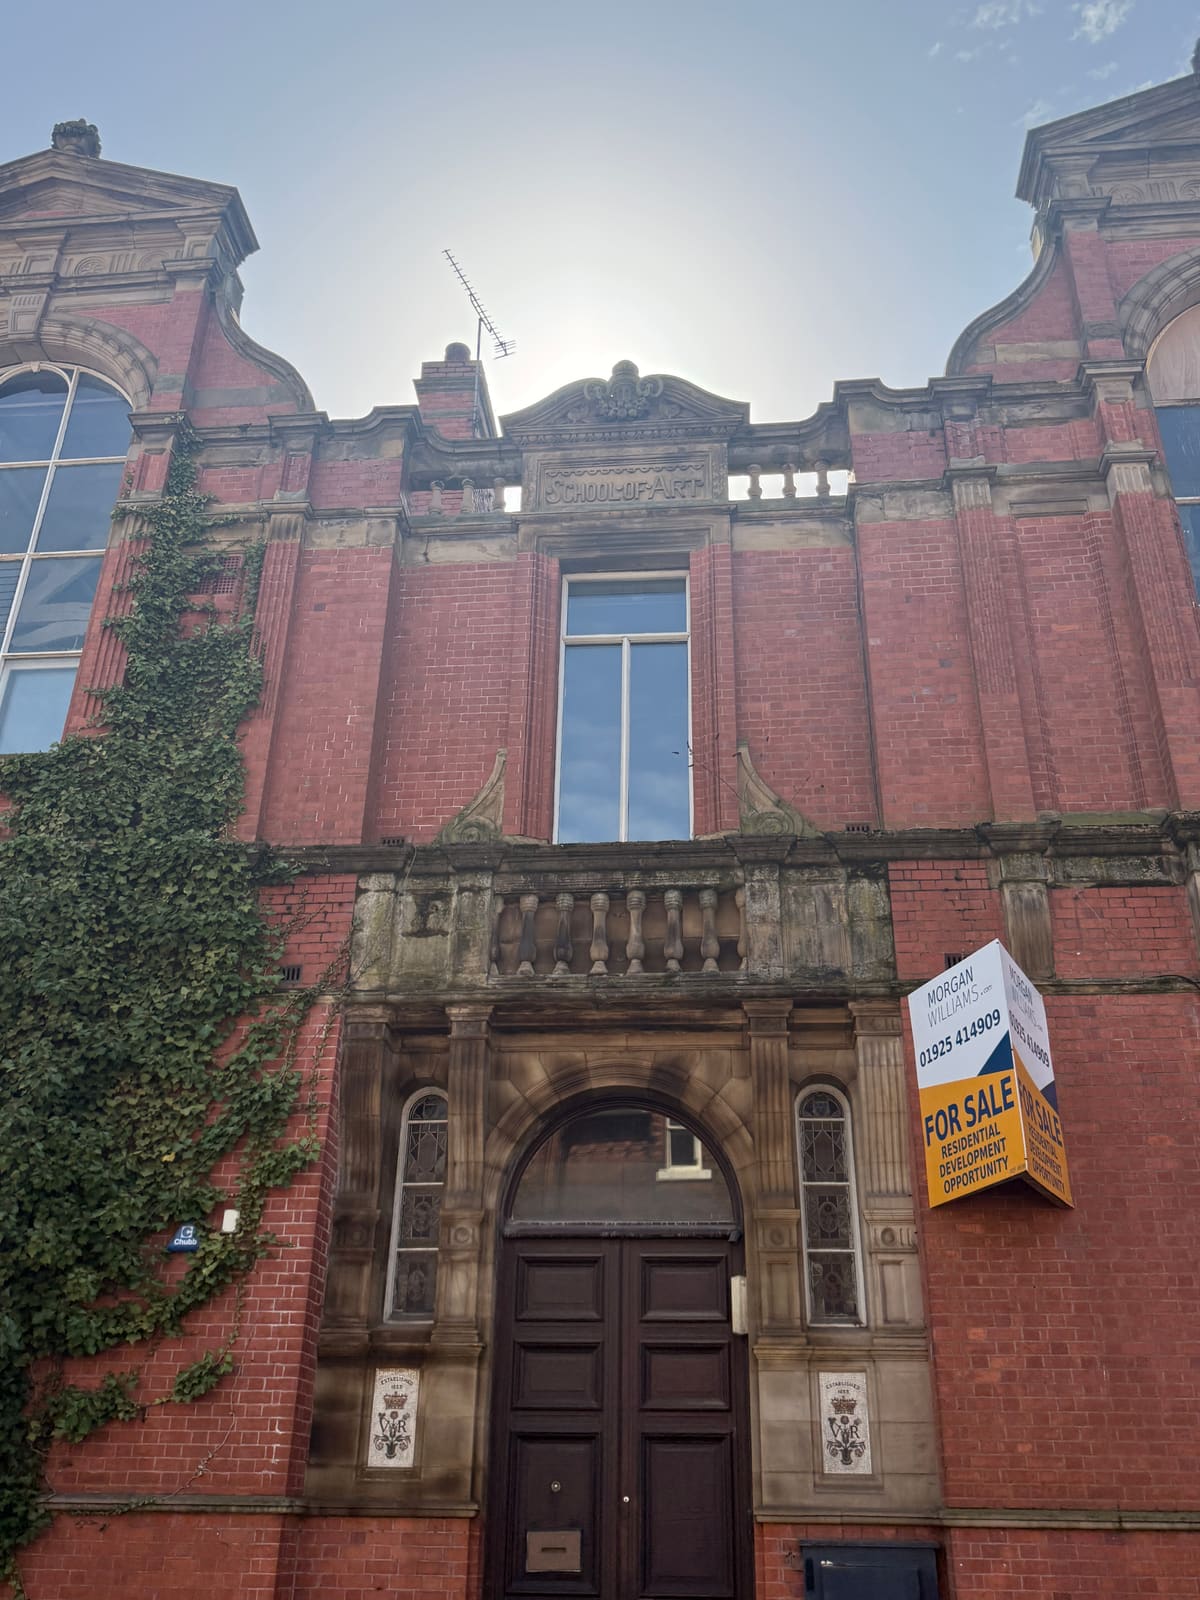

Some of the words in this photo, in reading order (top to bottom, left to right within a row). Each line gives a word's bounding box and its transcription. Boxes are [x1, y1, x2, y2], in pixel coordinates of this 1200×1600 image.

[927, 966, 974, 1008] MORGAN
[1009, 964, 1033, 1006] MORGAN
[919, 1036, 953, 1067] 01925
[955, 1009, 1001, 1045] 414909
[924, 1103, 962, 1147] FOR
[964, 1075, 1015, 1128] SALE
[1016, 1077, 1037, 1125] FOR
[1035, 1099, 1062, 1147] SALE
[939, 1137, 1007, 1178] DEVELOPMENT
[941, 1122, 1001, 1159] RESIDENTIAL
[943, 1156, 1009, 1194] OPPORTUNITY
[174, 1238, 197, 1246] Chubb
